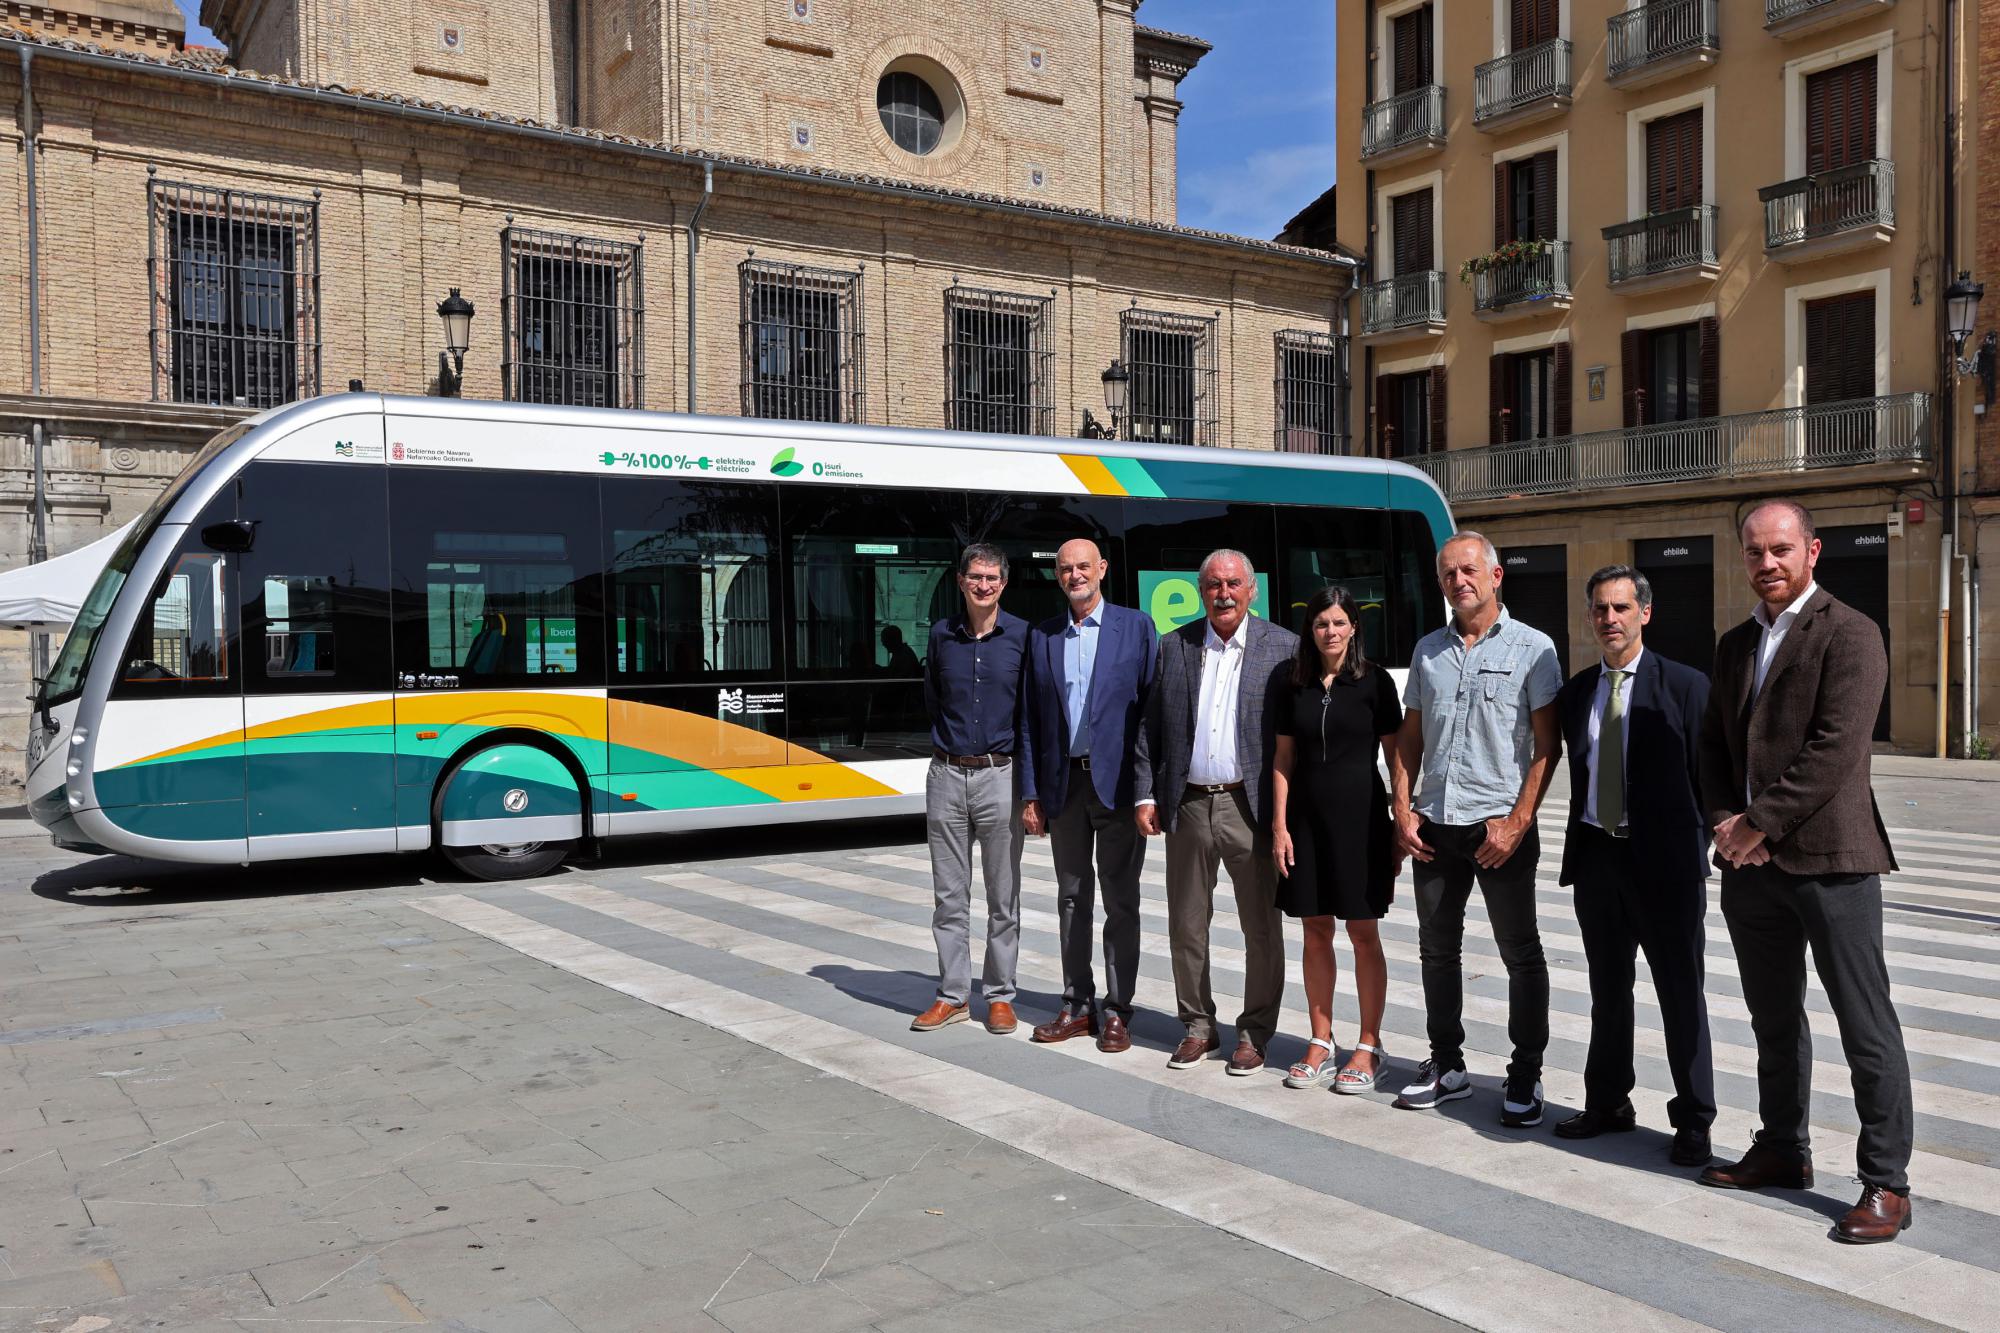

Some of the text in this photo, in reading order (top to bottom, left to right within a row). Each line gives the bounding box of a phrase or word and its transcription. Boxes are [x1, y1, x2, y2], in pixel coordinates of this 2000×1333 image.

[446, 449, 471, 457] Navarra
[715, 457, 756, 466] elektrikoa
[824, 461, 842, 470] isuri
[812, 461, 824, 477] 0
[824, 469, 864, 478] emisiones
[1854, 535, 1886, 545] ehbildu
[1663, 546, 1689, 556] ehbildu
